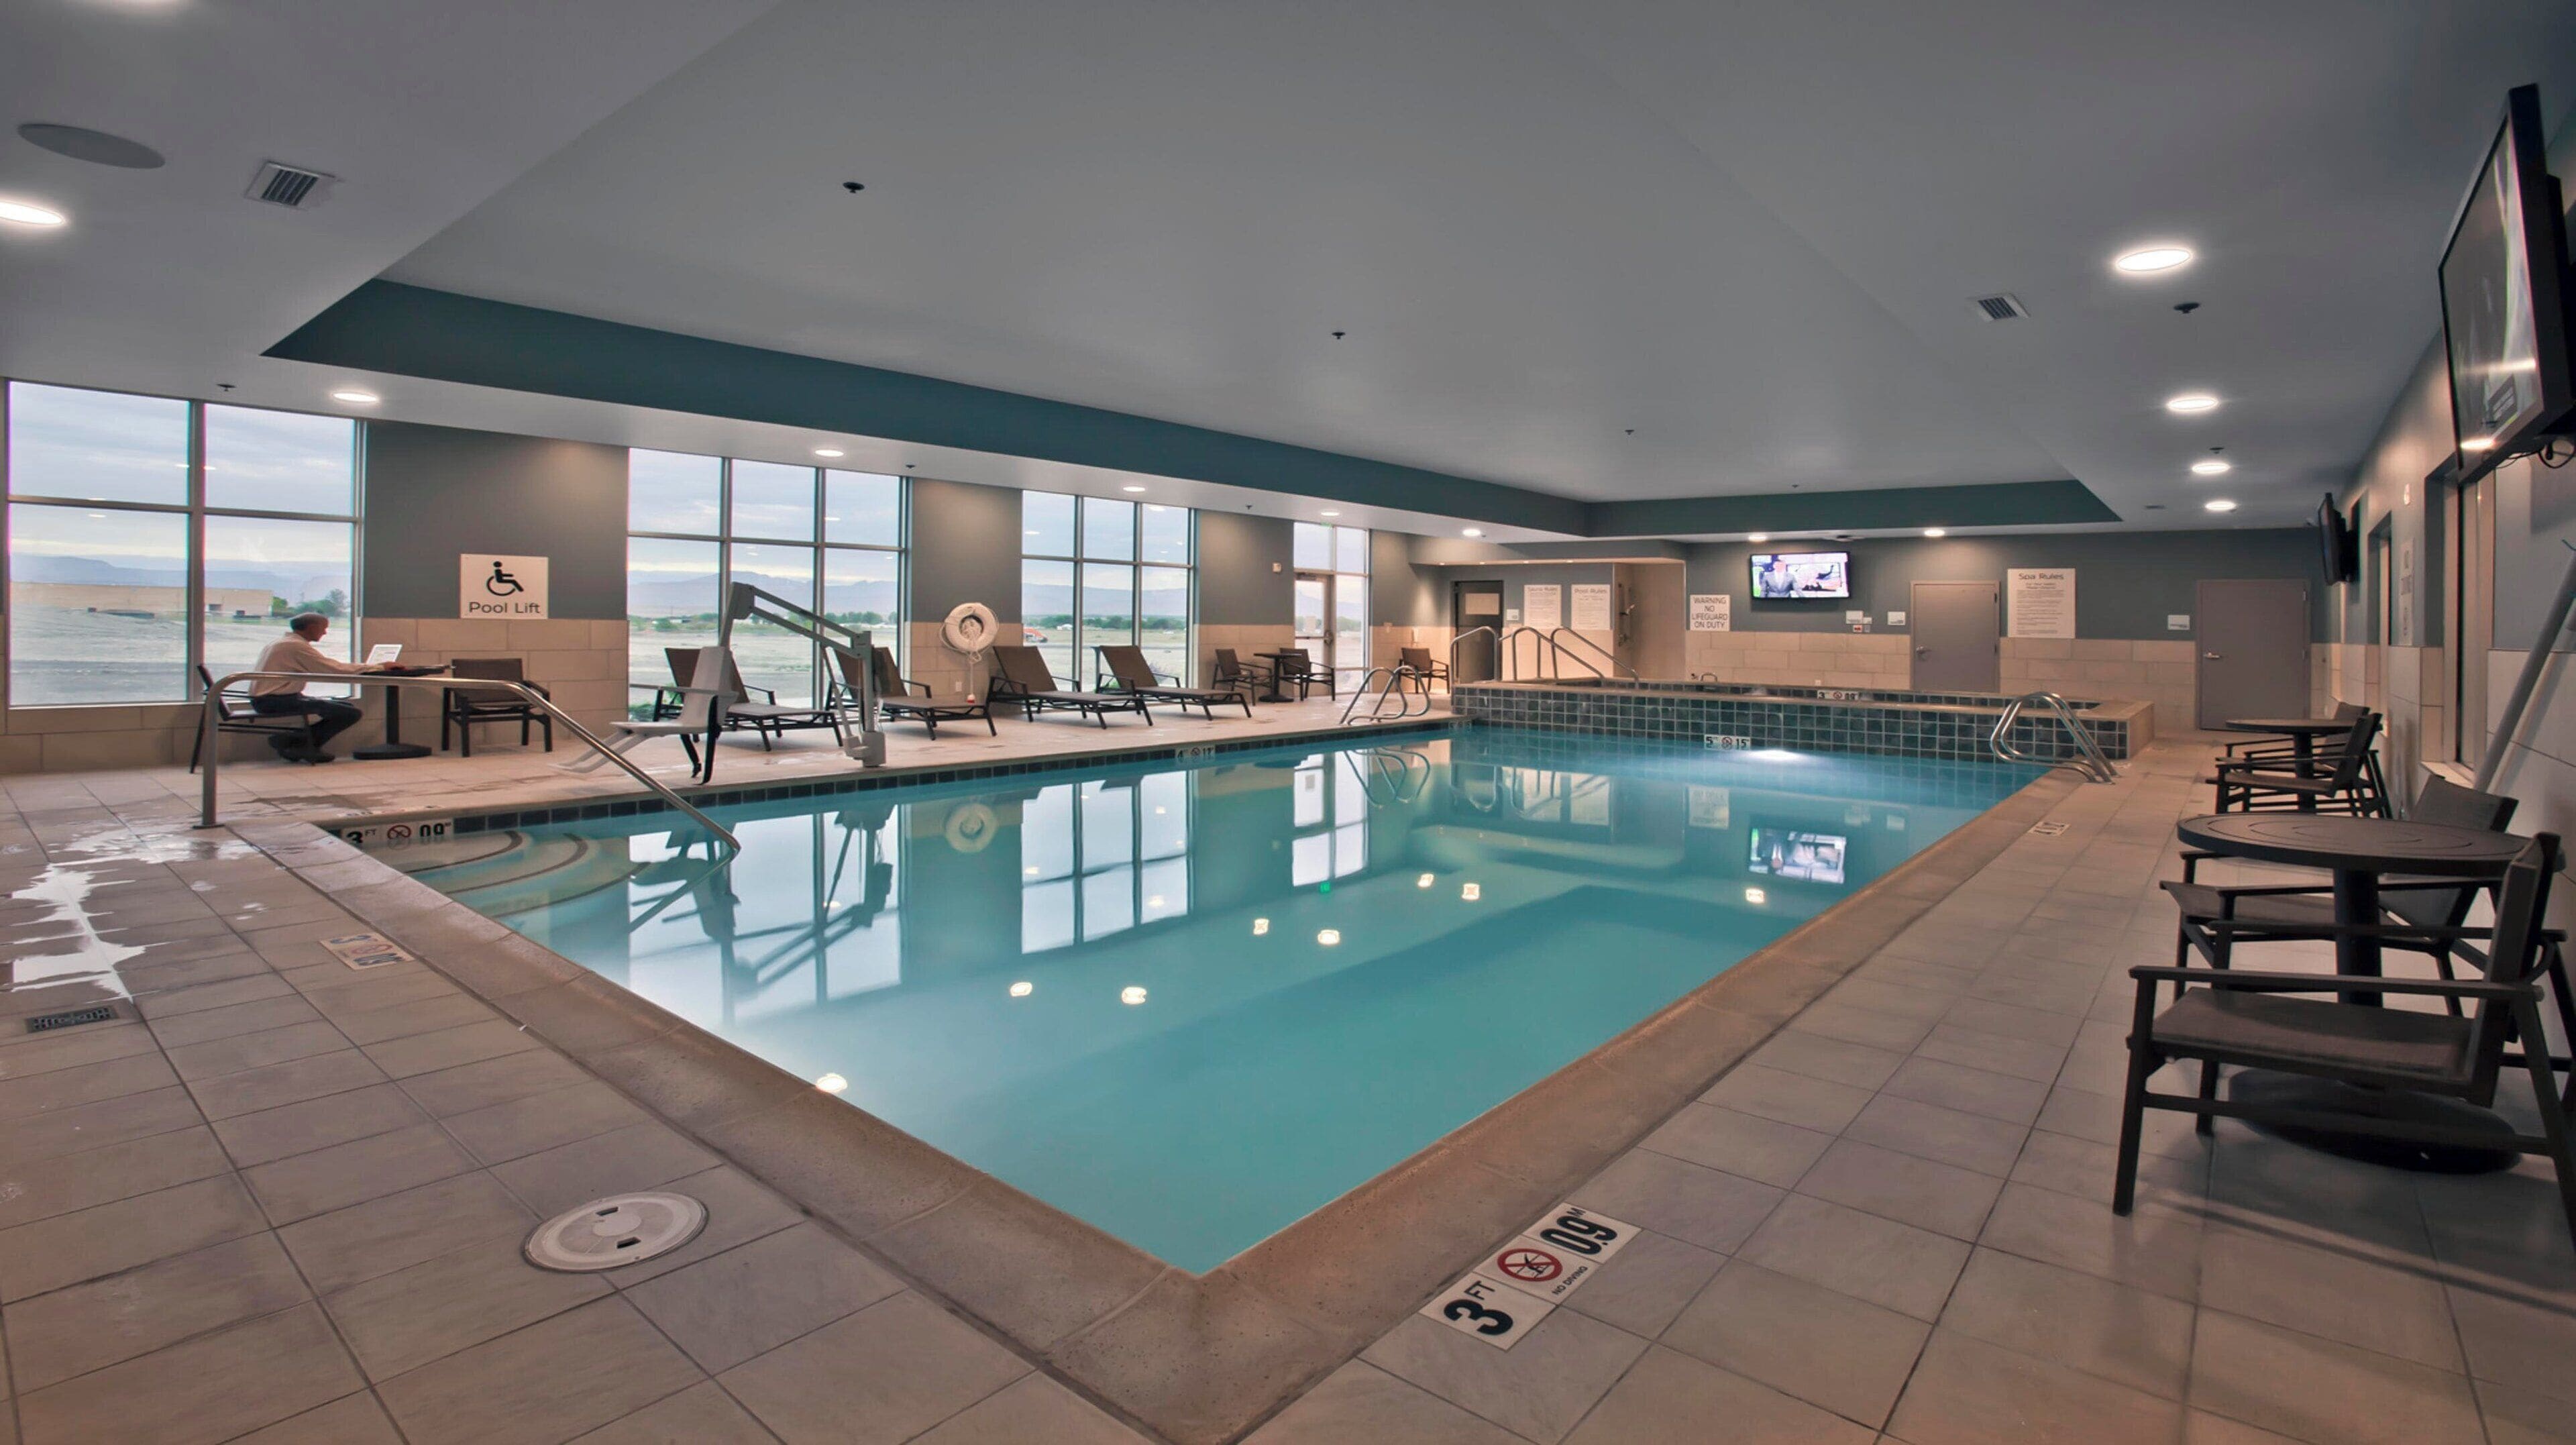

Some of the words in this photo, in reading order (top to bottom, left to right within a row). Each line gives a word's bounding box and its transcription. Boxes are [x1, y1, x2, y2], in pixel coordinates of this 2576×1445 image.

[1693, 596, 1727, 604] WARNING
[469, 602, 508, 613] Pool
[515, 602, 541, 614] Lift
[1691, 612, 1728, 621] LIFEGUARD
[1566, 1207, 1587, 1218] M
[1552, 1283, 1566, 1295] NO
[1564, 1265, 1589, 1287] DIVING
[1464, 1280, 1495, 1300] FT
[1444, 1299, 1514, 1336] 3
